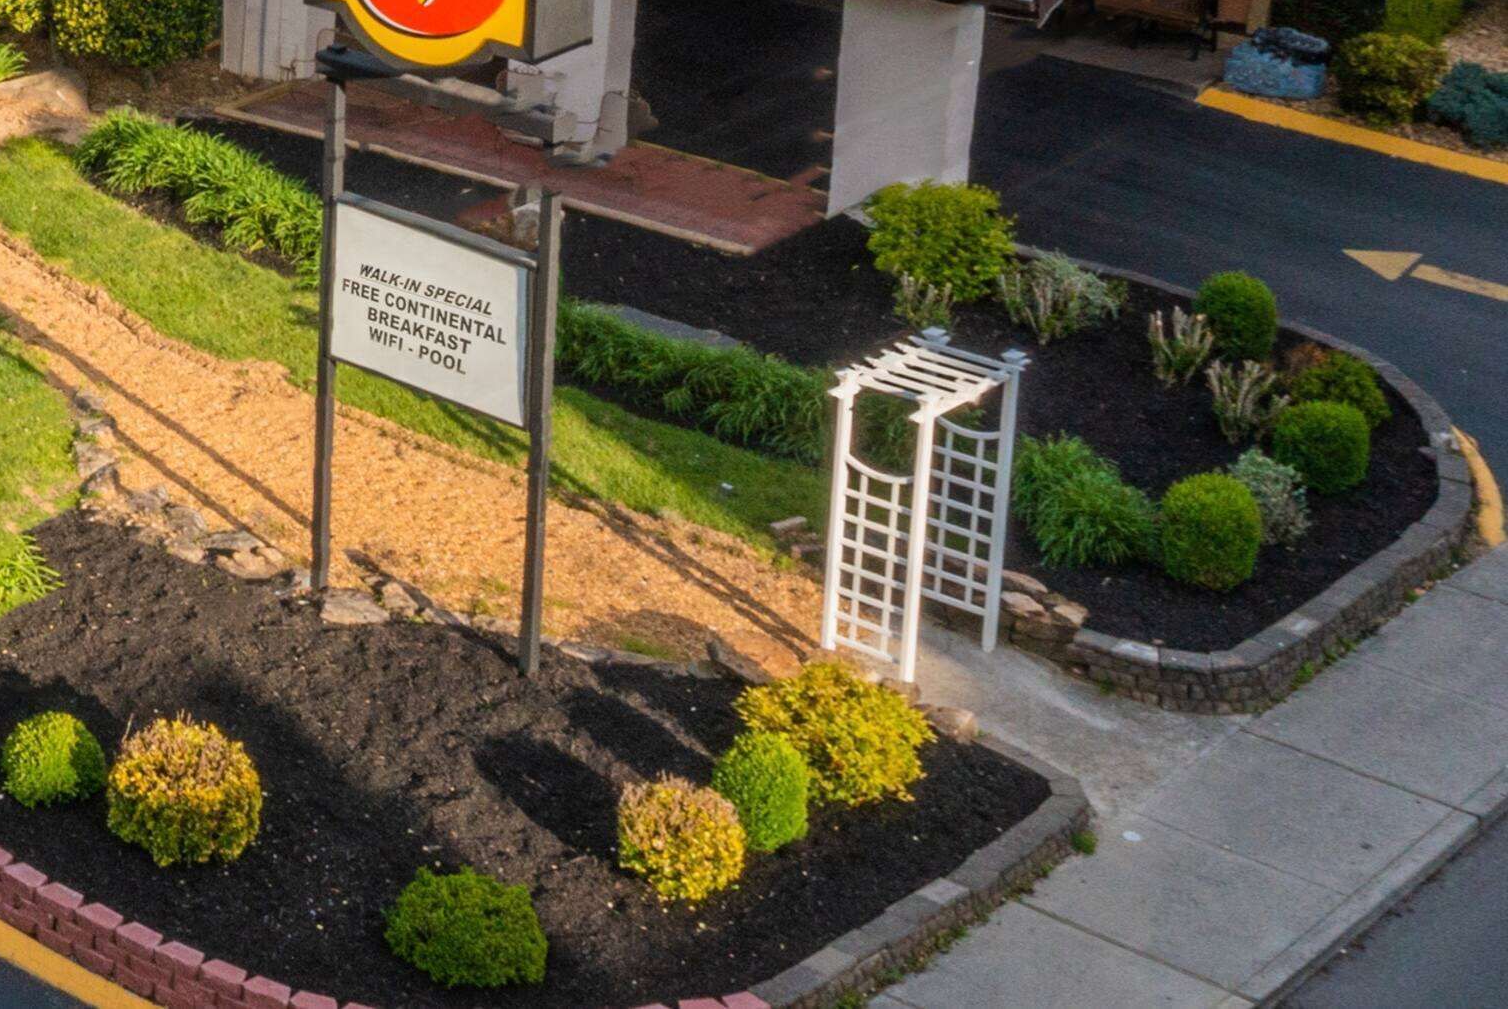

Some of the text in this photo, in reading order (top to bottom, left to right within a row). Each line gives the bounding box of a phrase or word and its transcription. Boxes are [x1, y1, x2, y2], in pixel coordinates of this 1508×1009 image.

[342, 278, 508, 345] FREE CONTINENTAL
[359, 263, 493, 315] WALK-IN SPECIAL
[367, 307, 472, 354] BREAKFAST
[369, 326, 404, 351] WIFI
[418, 345, 467, 375] POOL
